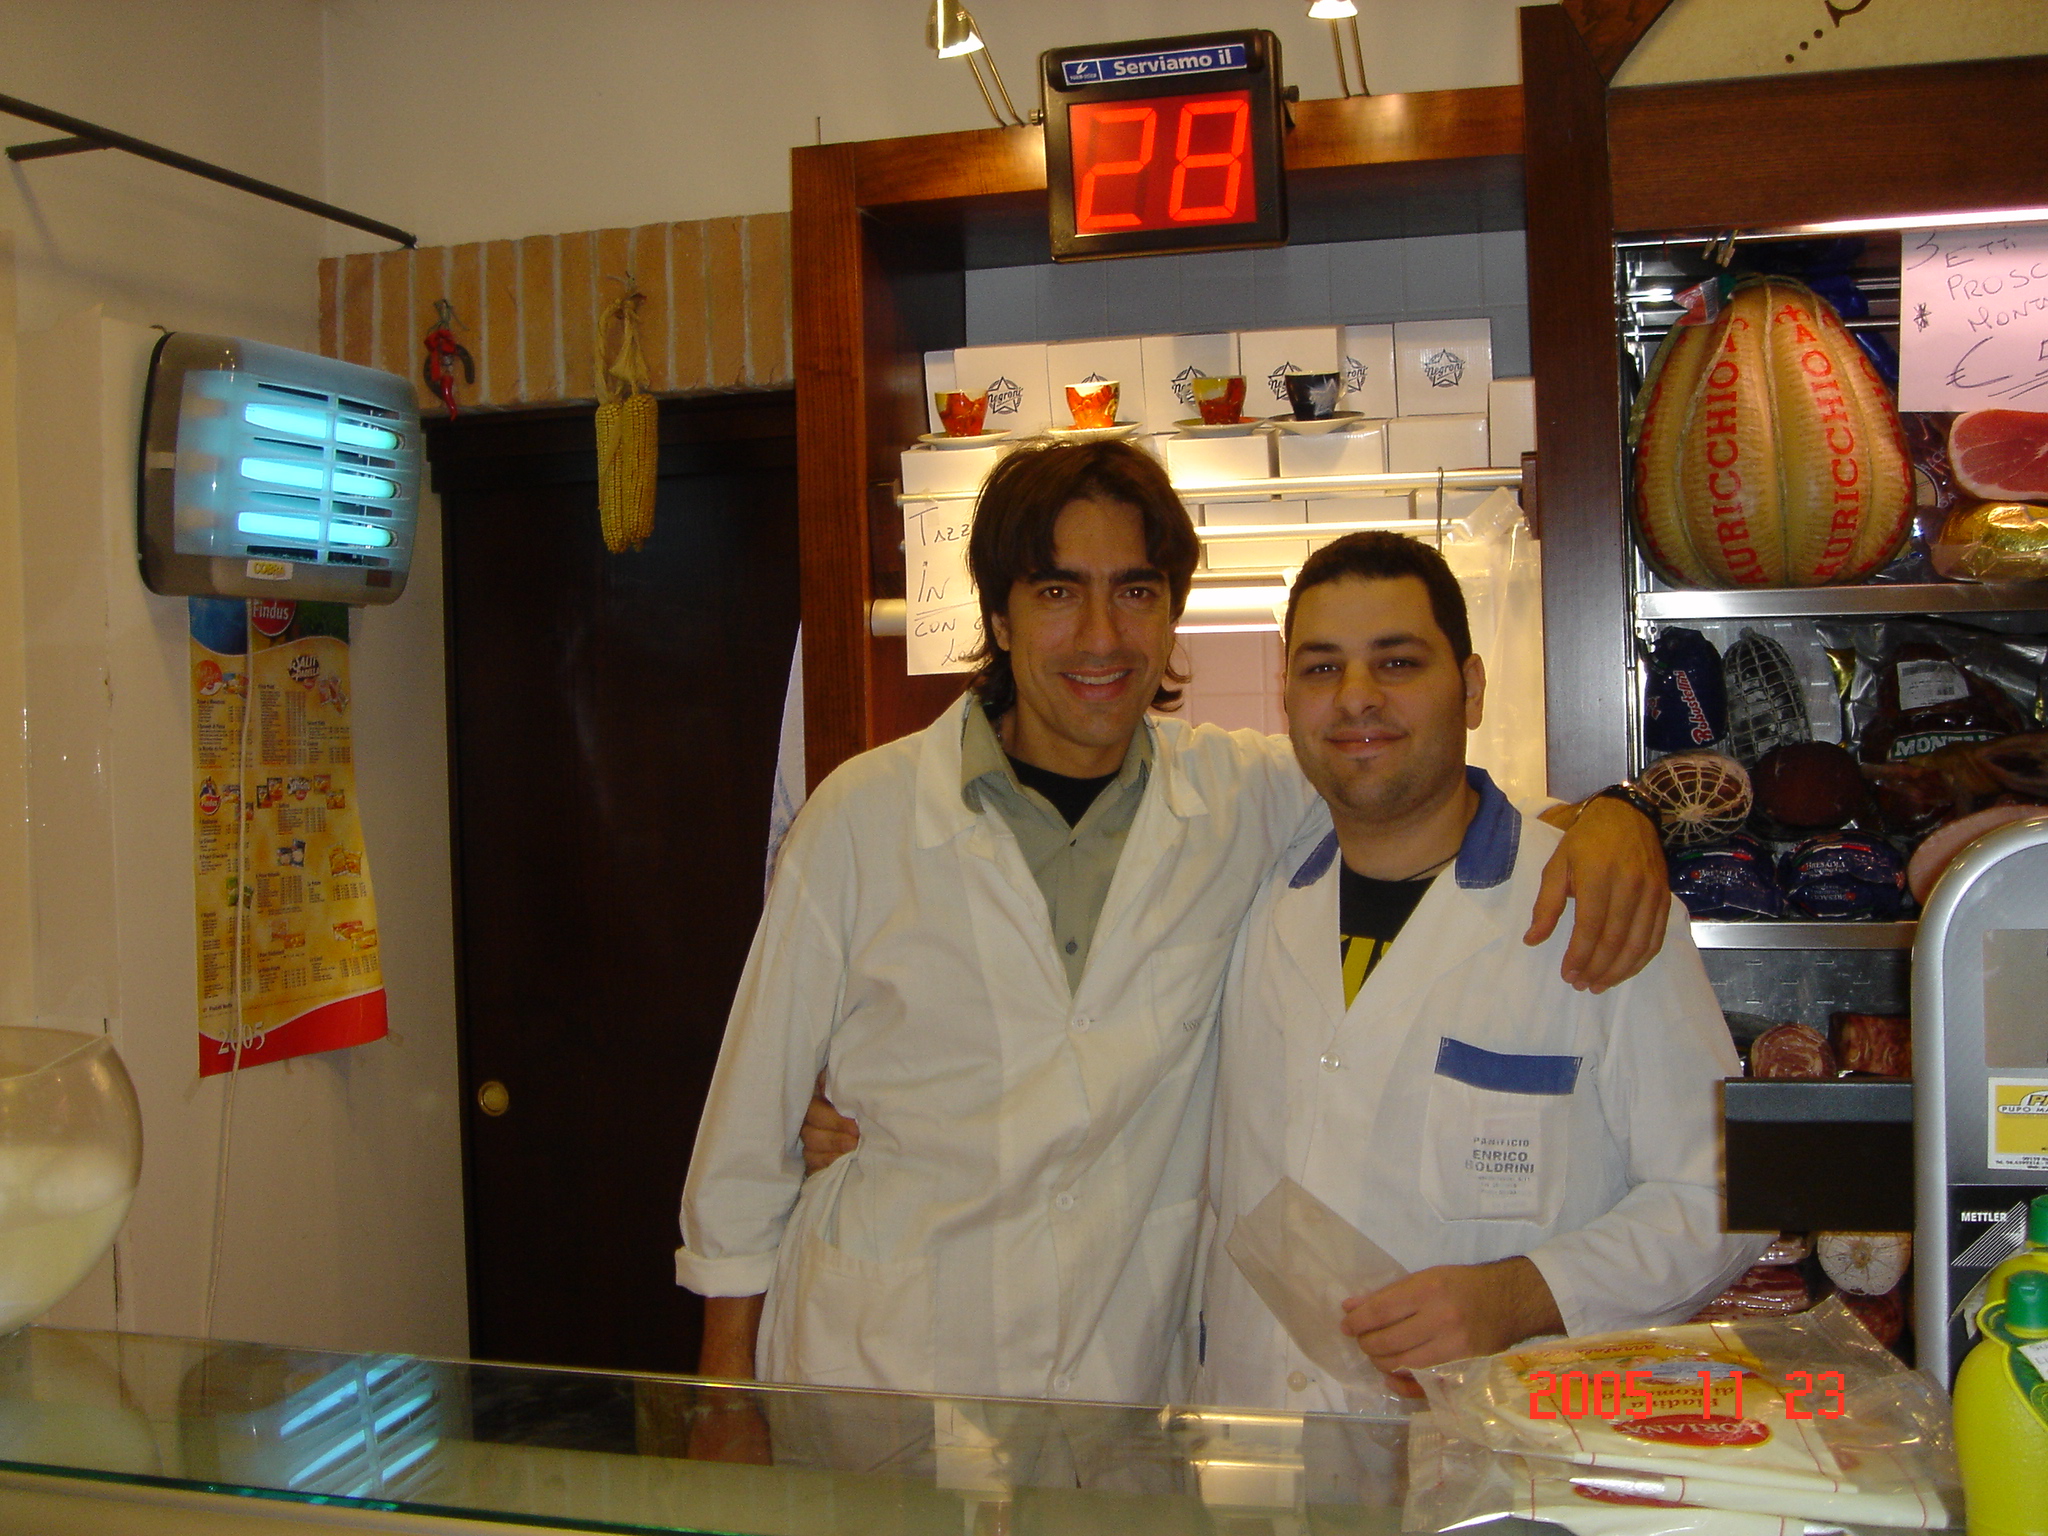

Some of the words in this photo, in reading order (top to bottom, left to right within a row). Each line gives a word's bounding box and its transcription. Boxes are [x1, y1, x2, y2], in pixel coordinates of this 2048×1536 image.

[1113, 55, 1212, 76] Serviamo
[1219, 49, 1232, 65] il
[1078, 99, 1249, 229] 28
[1706, 361, 1770, 586] AURICCHIO
[1800, 350, 1859, 577] AURICCHIO
[252, 601, 289, 620] Findus
[1673, 670, 1714, 745] Robustellini
[1465, 1160, 1534, 1173] BOLDRINI
[1472, 1149, 1528, 1162] ENRICO
[1961, 1212, 2007, 1222] METTLER
[1623, 1421, 1761, 1438] LORIANA
